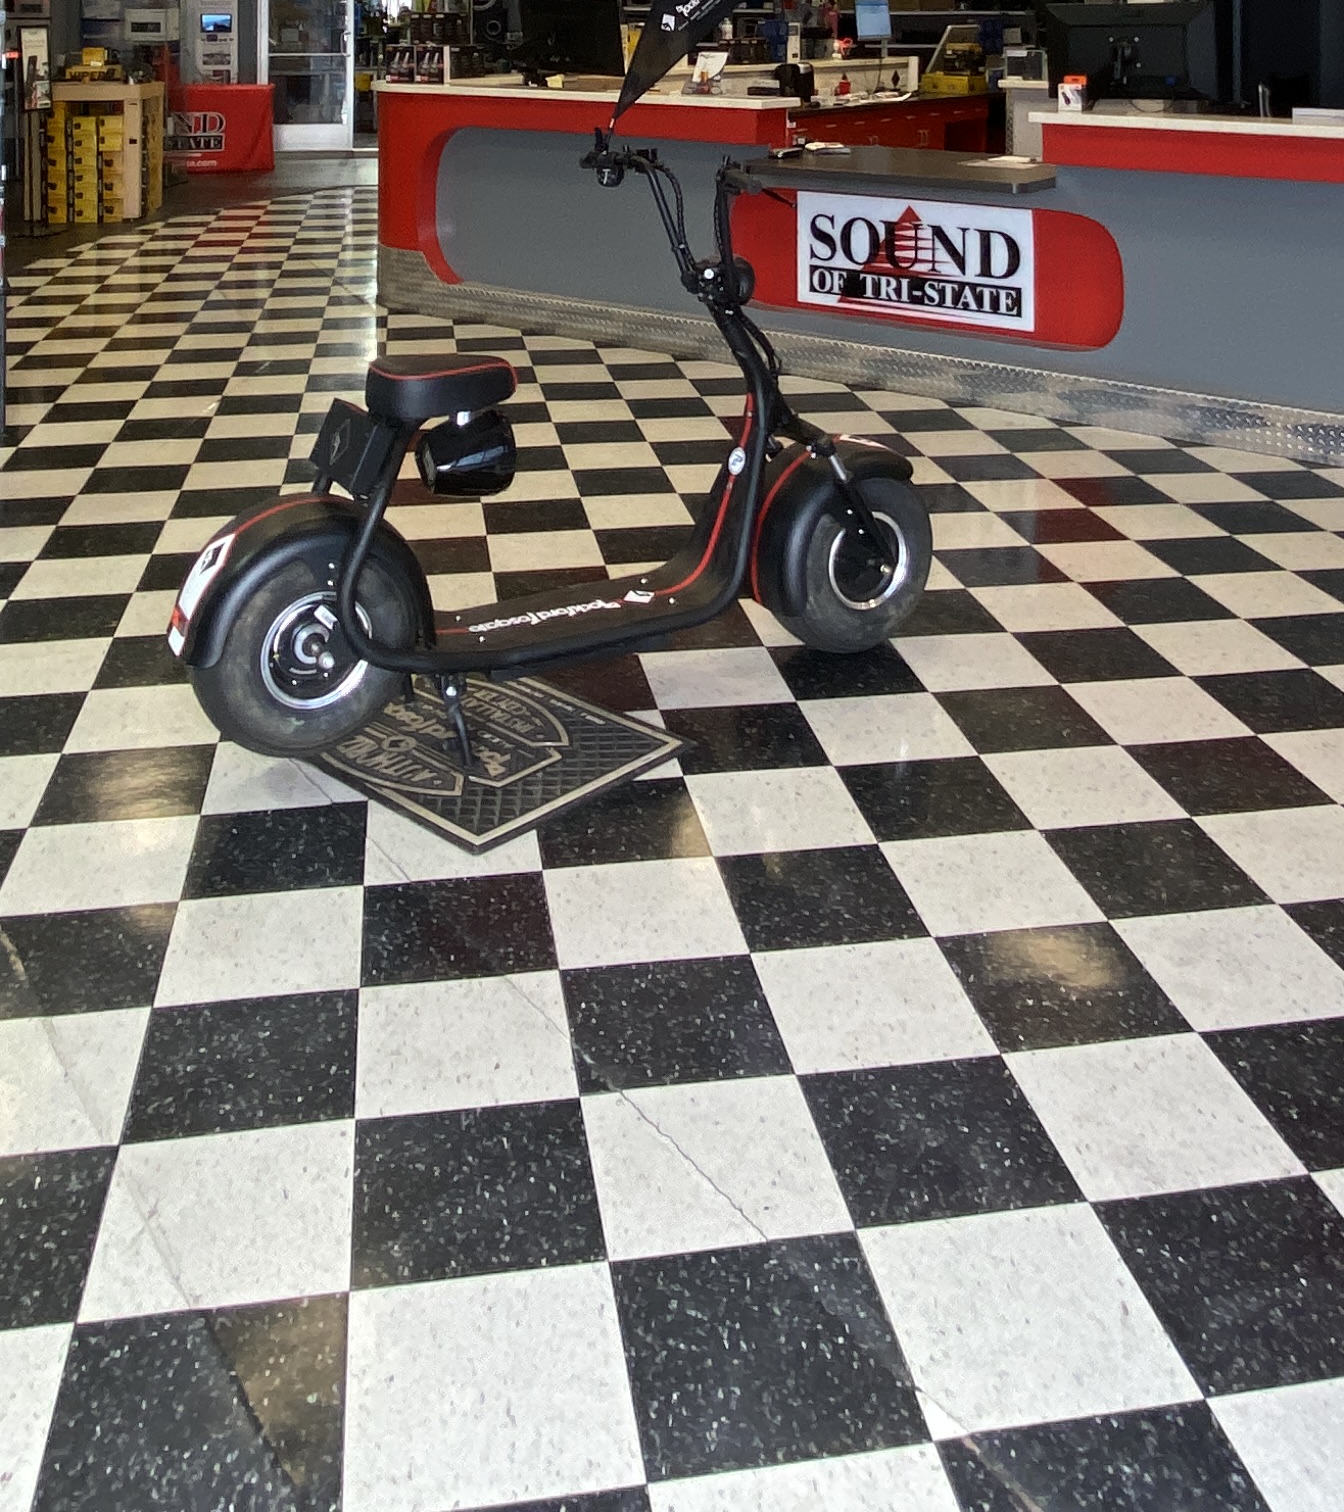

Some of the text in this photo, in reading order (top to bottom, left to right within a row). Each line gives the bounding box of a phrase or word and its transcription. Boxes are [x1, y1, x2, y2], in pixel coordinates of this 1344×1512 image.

[809, 213, 1021, 280] SOUND
[812, 269, 1019, 317] OF TRI-STATE
